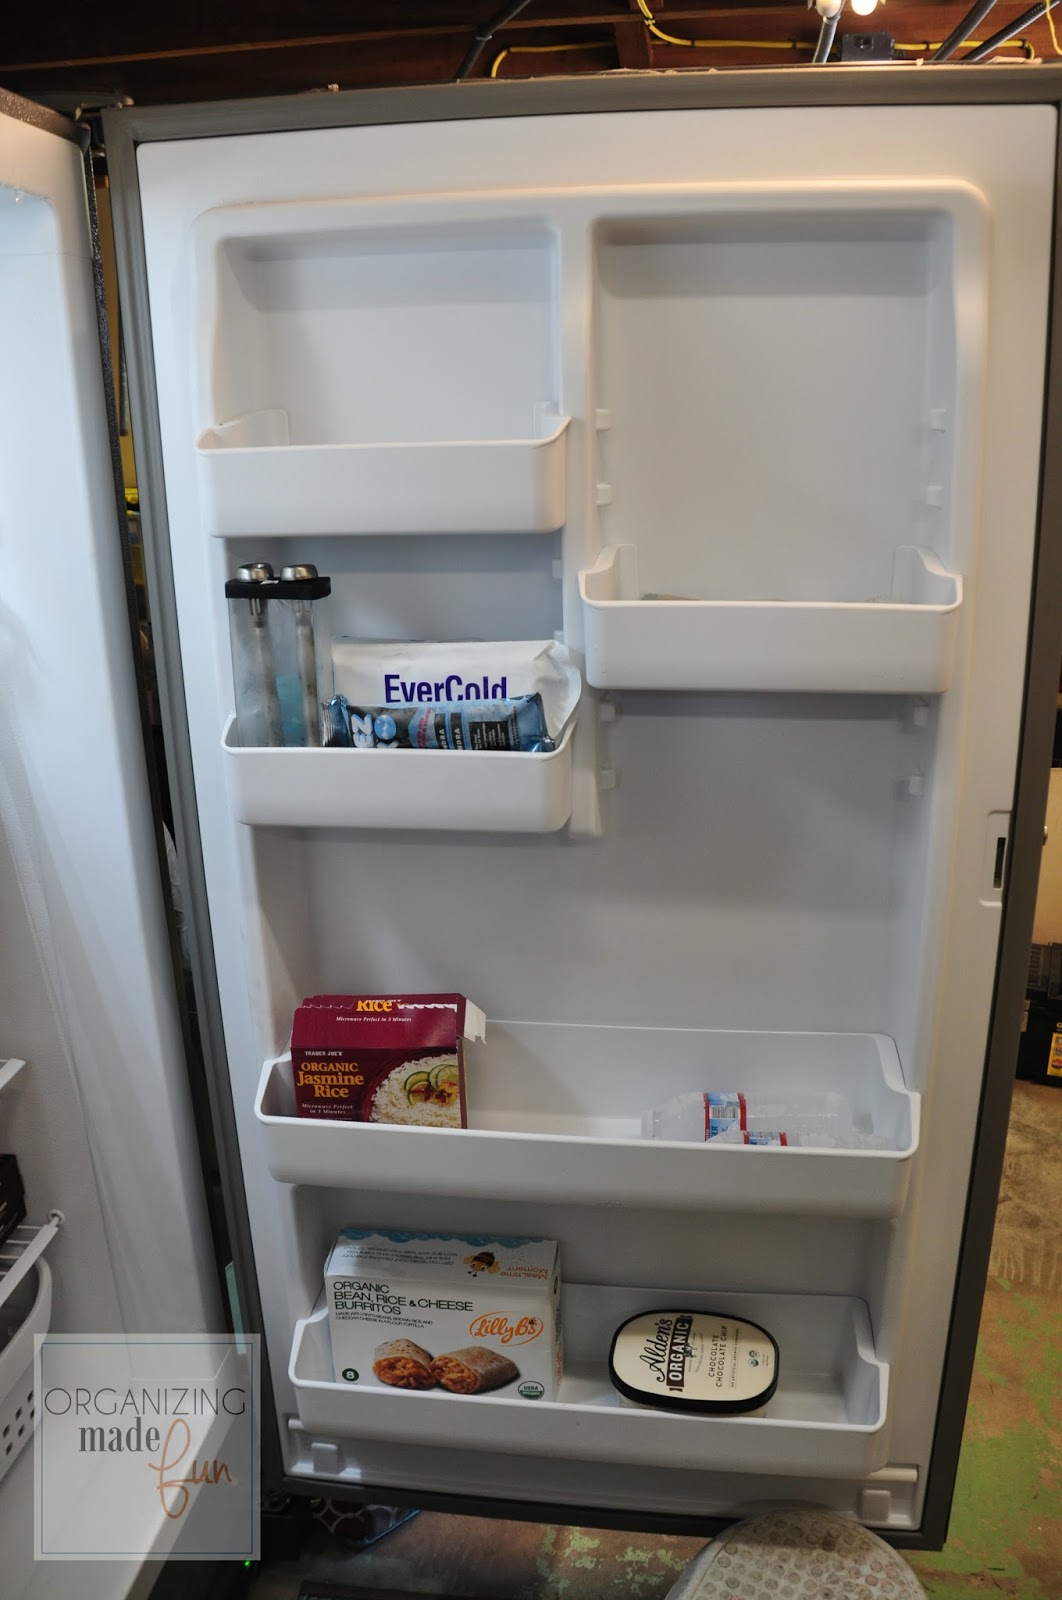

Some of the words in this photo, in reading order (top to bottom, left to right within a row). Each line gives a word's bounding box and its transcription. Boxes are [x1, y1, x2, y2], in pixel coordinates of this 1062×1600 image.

[384, 674, 507, 703] EverCold
[301, 1062, 358, 1072] ORGANIC
[297, 1071, 364, 1086] Jasmine
[313, 1085, 349, 1098] Rice
[333, 1281, 390, 1294] ORGANIC
[334, 1291, 374, 1302] BEAN,
[376, 1294, 407, 1306] RICE
[418, 1299, 474, 1311] CHEESE
[335, 1301, 401, 1315] BURRITOS
[640, 1319, 673, 1382] Alden's
[669, 1322, 689, 1381] ORGANIC
[708, 1334, 719, 1377] CHOCOLATE
[716, 1343, 726, 1387] CHOCOLATE
[346, 1371, 356, 1379] 8
